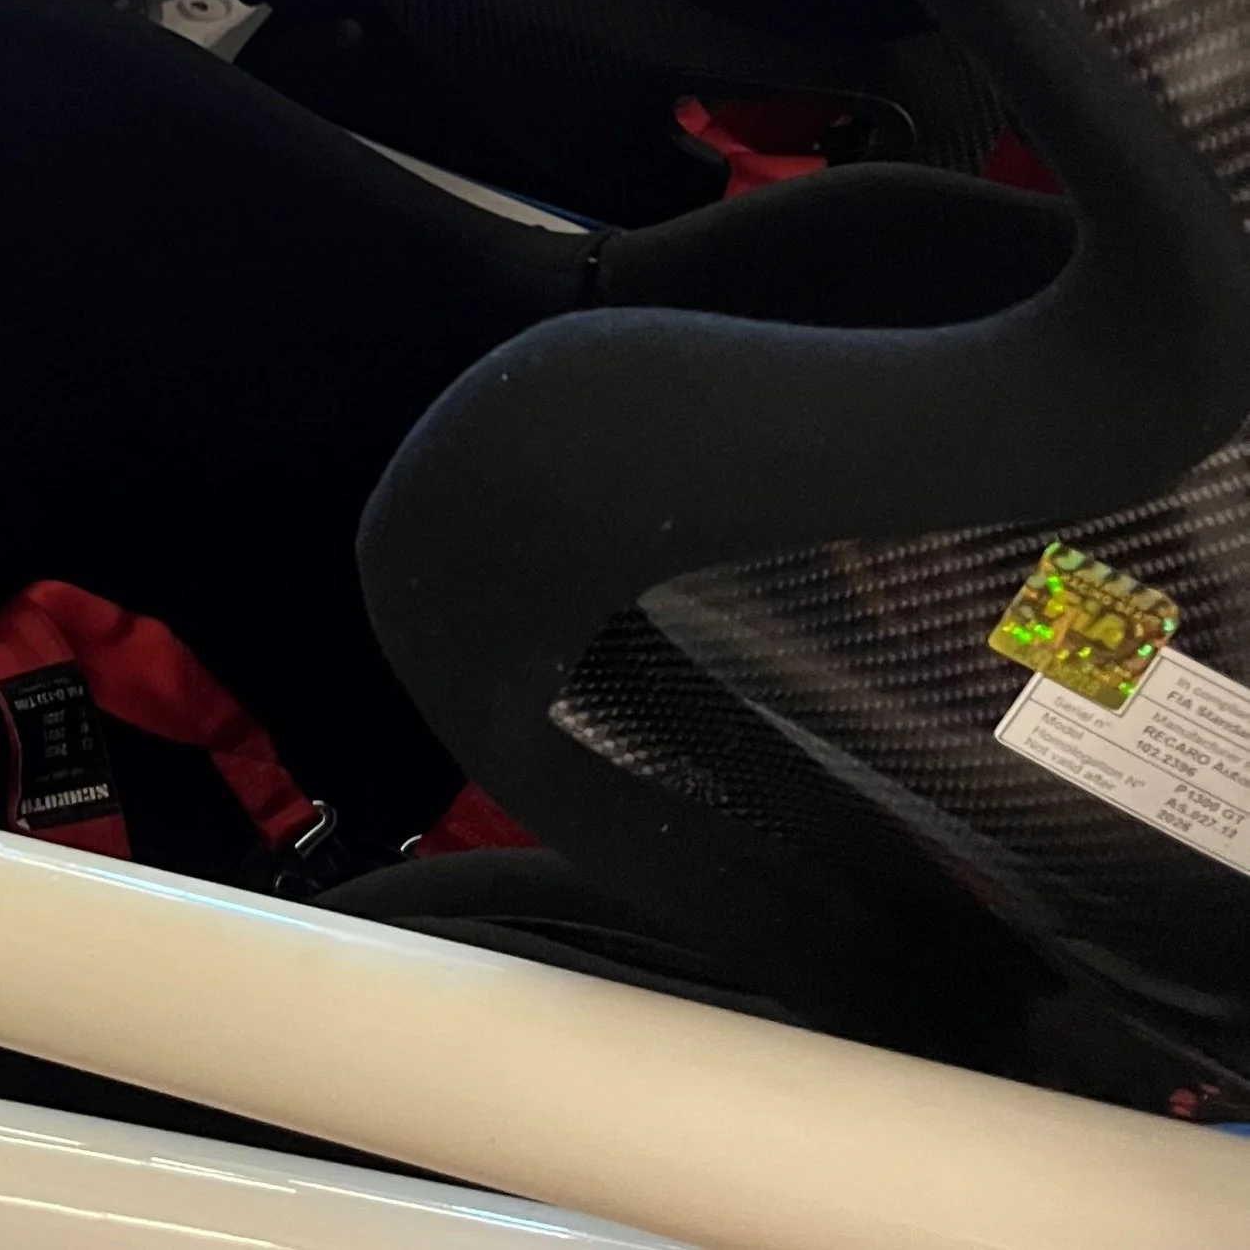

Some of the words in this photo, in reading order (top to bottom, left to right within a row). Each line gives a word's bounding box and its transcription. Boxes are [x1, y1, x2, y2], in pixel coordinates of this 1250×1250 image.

[1166, 690, 1193, 710] FIA
[1042, 712, 1085, 740] Model
[1143, 725, 1211, 765] RECARO
